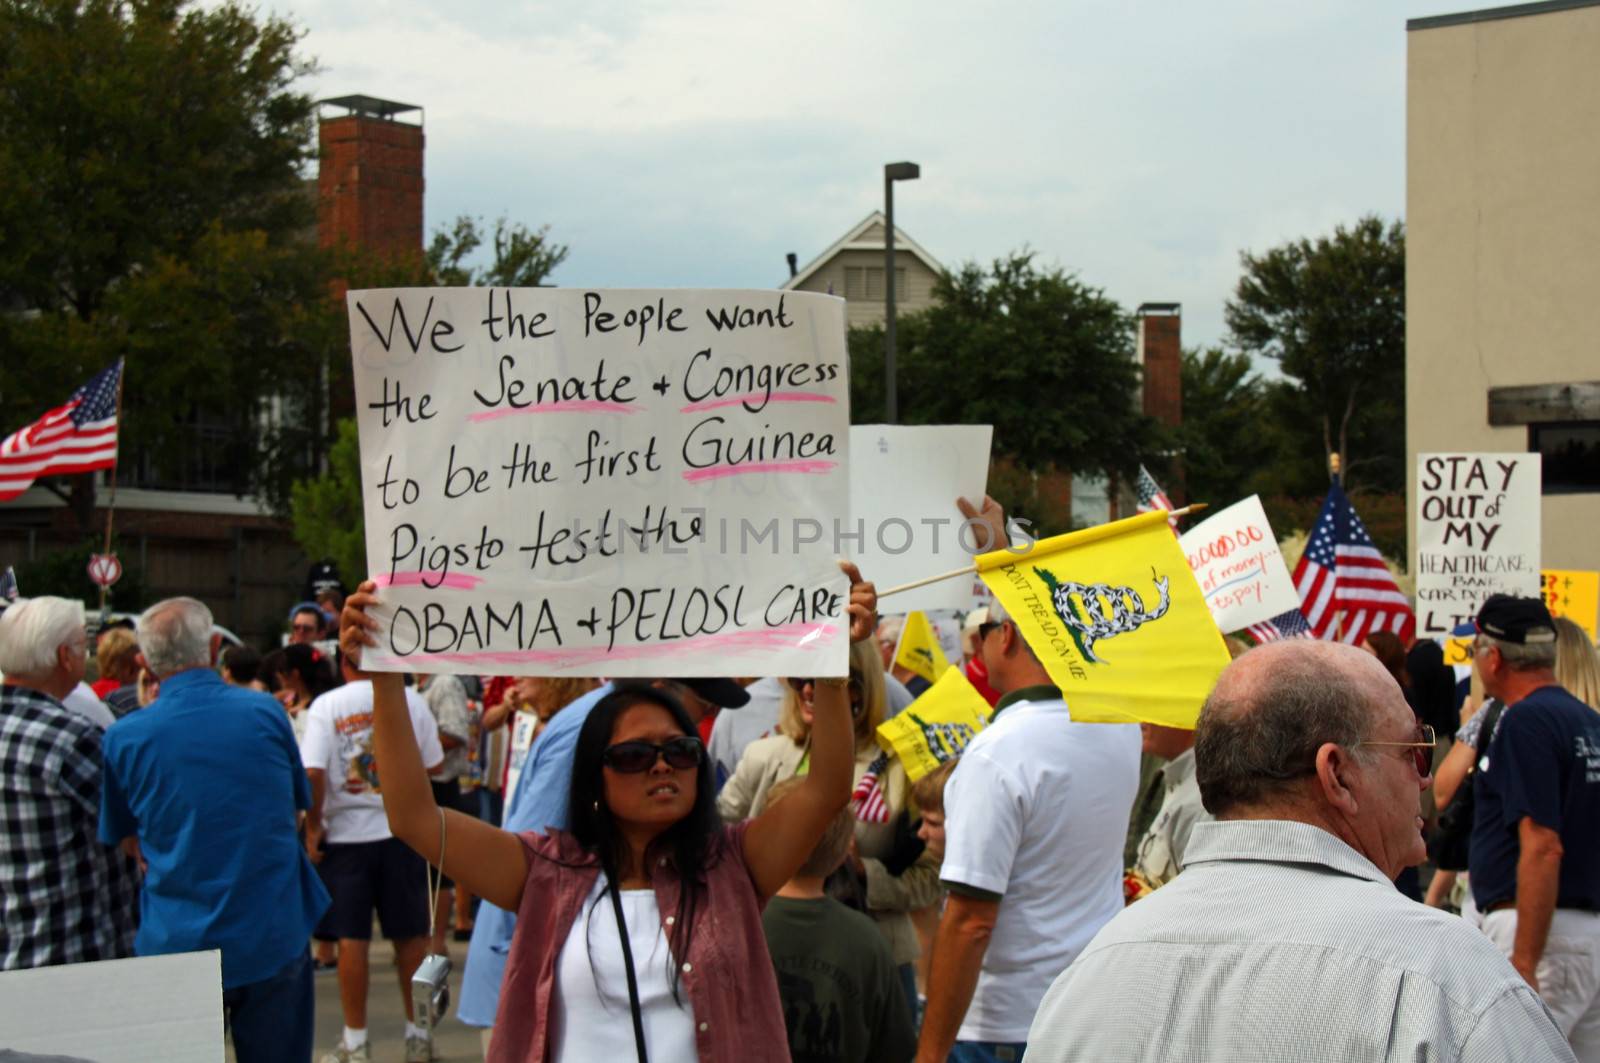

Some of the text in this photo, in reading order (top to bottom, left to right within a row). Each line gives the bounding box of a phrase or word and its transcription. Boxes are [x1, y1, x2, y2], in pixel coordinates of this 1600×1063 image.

[356, 288, 794, 355] We the People want
[369, 377, 438, 428] the
[473, 354, 637, 409] Senate
[683, 348, 839, 414] Congress
[376, 416, 836, 510] to be the first Guinea
[1422, 457, 1518, 491] STAY
[519, 508, 618, 570] test
[630, 504, 703, 553] the
[1422, 494, 1506, 521] OUT of
[1442, 521, 1502, 551] MY
[1203, 568, 1216, 591] of
[390, 599, 562, 657] OBAMA
[606, 584, 747, 652] PELOSI
[763, 583, 843, 629] CARE
